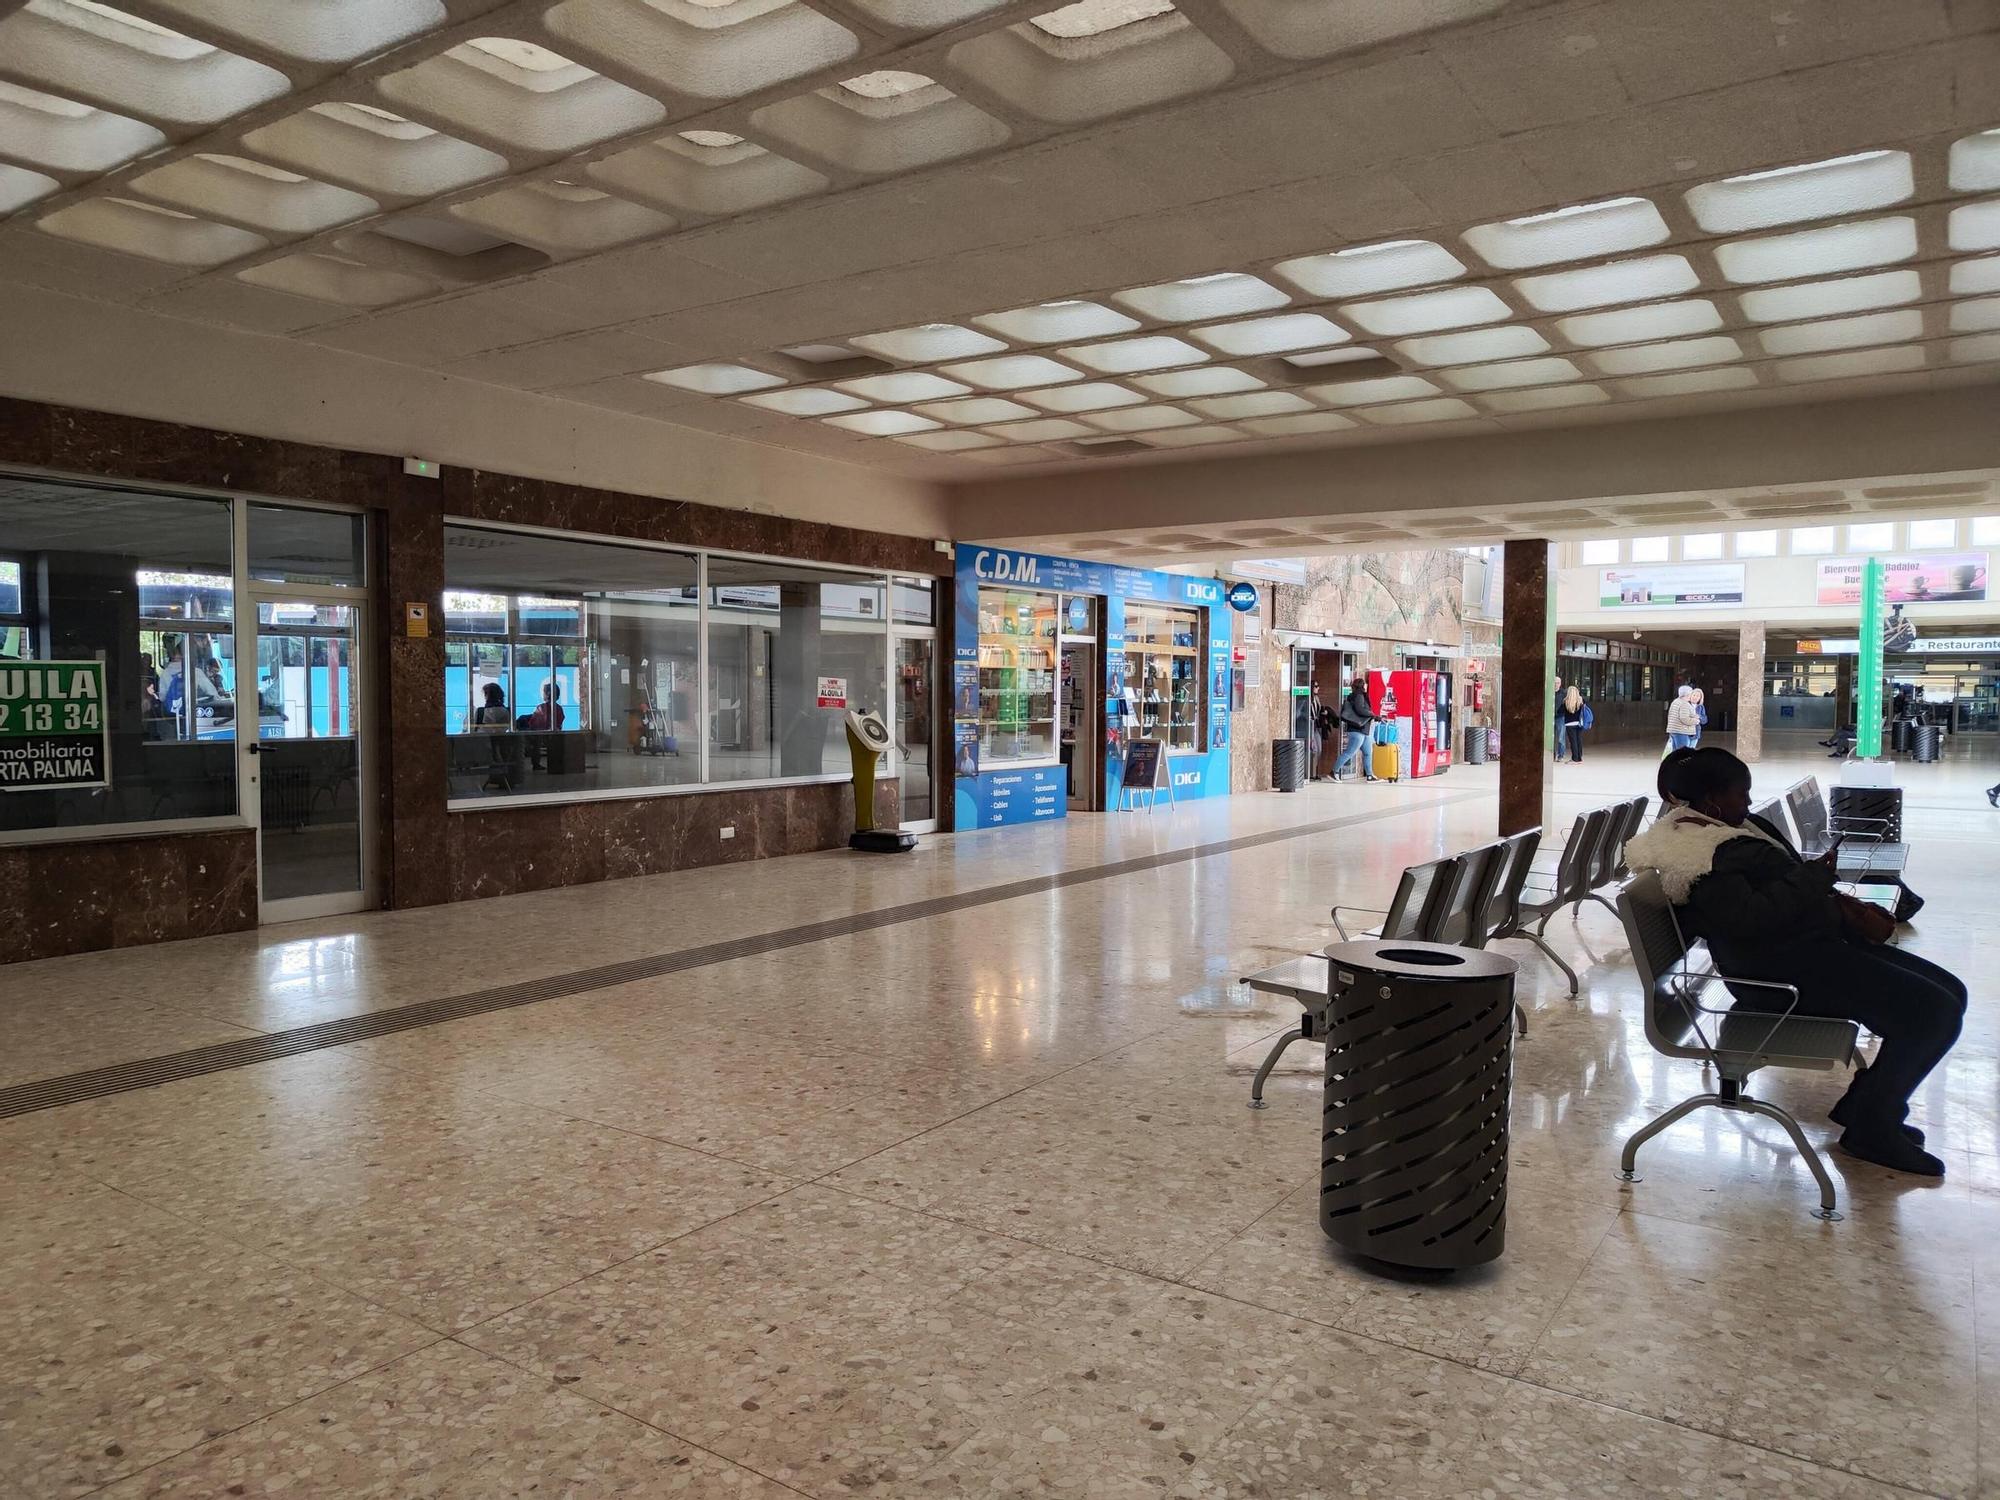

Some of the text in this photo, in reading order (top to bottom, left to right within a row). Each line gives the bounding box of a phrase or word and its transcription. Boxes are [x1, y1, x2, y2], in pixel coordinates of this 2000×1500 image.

[975, 550, 1041, 584] C.D.M.
[1824, 562, 1920, 574] Bienveni Badajoz
[1844, 575, 1861, 584] Bue
[1187, 583, 1217, 600] DIGI
[1928, 640, 2000, 650] Restaurante
[957, 648, 976, 656] DIGI
[821, 689, 843, 697] ALQUILA
[20, 703, 52, 731] 13
[64, 703, 99, 730] 34
[34, 759, 95, 779] PALMA
[1174, 772, 1200, 785] DIGI
